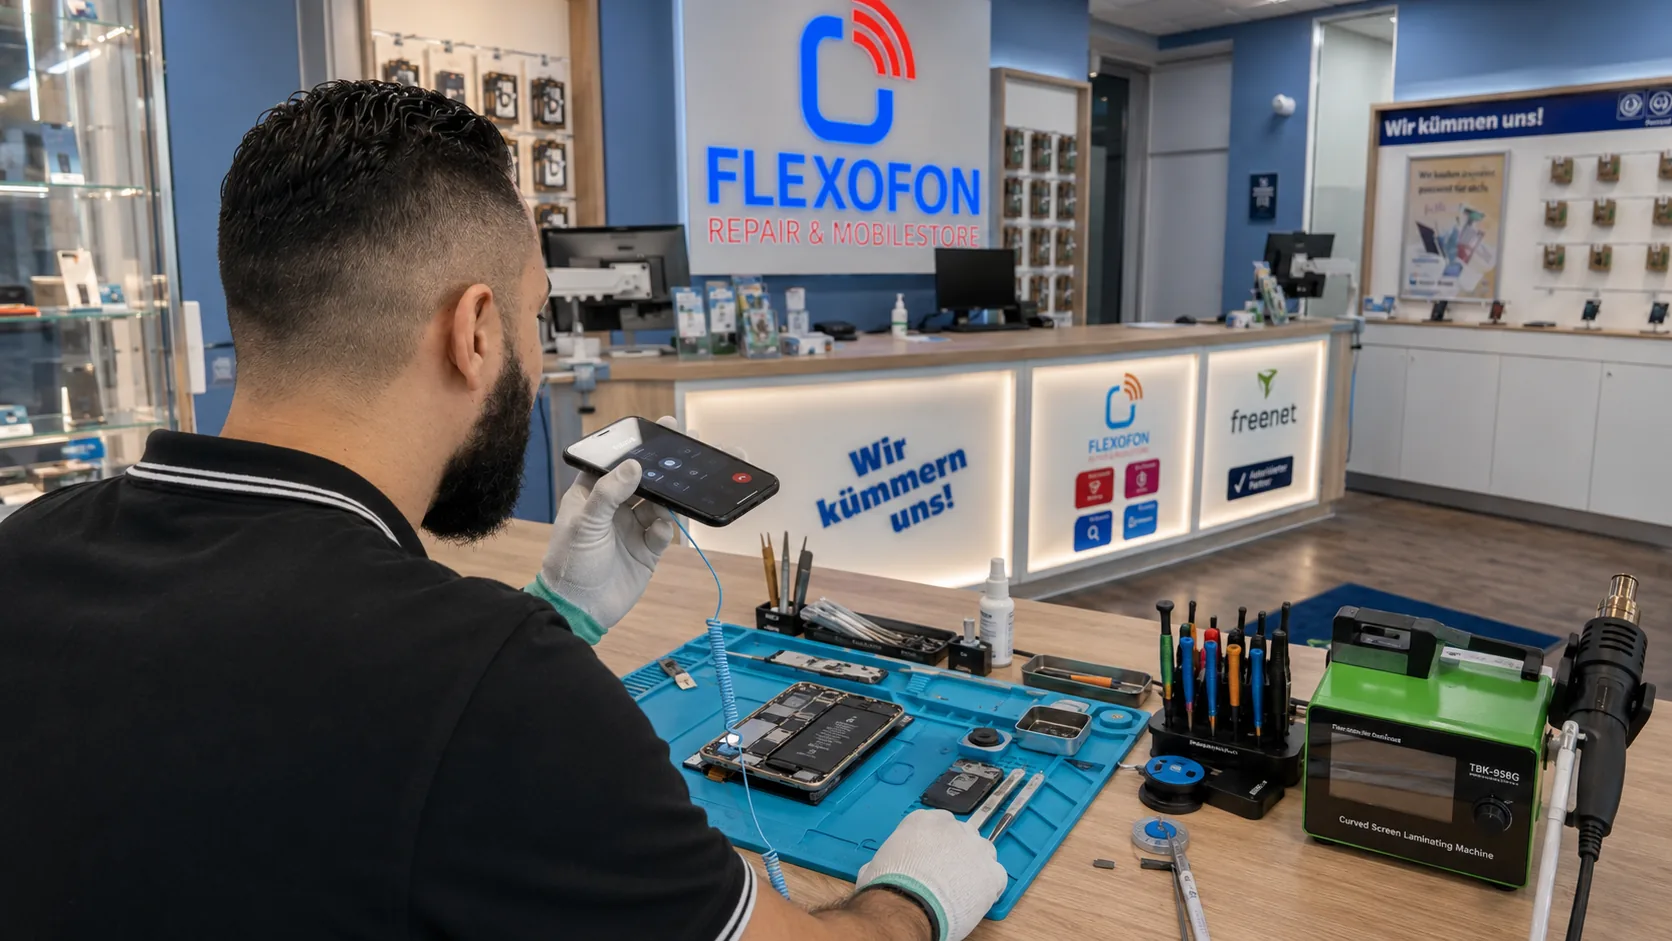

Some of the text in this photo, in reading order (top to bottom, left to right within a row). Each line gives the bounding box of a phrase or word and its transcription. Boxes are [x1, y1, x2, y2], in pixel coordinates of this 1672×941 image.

[1384, 118, 1416, 138] Wir
[1502, 107, 1544, 129] uns!
[707, 146, 981, 216] FLEXOFON
[708, 217, 979, 248] REPAIR & MOBILESTORE
[1231, 403, 1297, 434] freenet
[849, 436, 907, 477] Wir
[1088, 432, 1150, 454] FLEXOFON
[816, 448, 968, 529] kümmern
[890, 483, 955, 533] uns!
[1339, 815, 1494, 860] Curved Screen Laminating Machine
